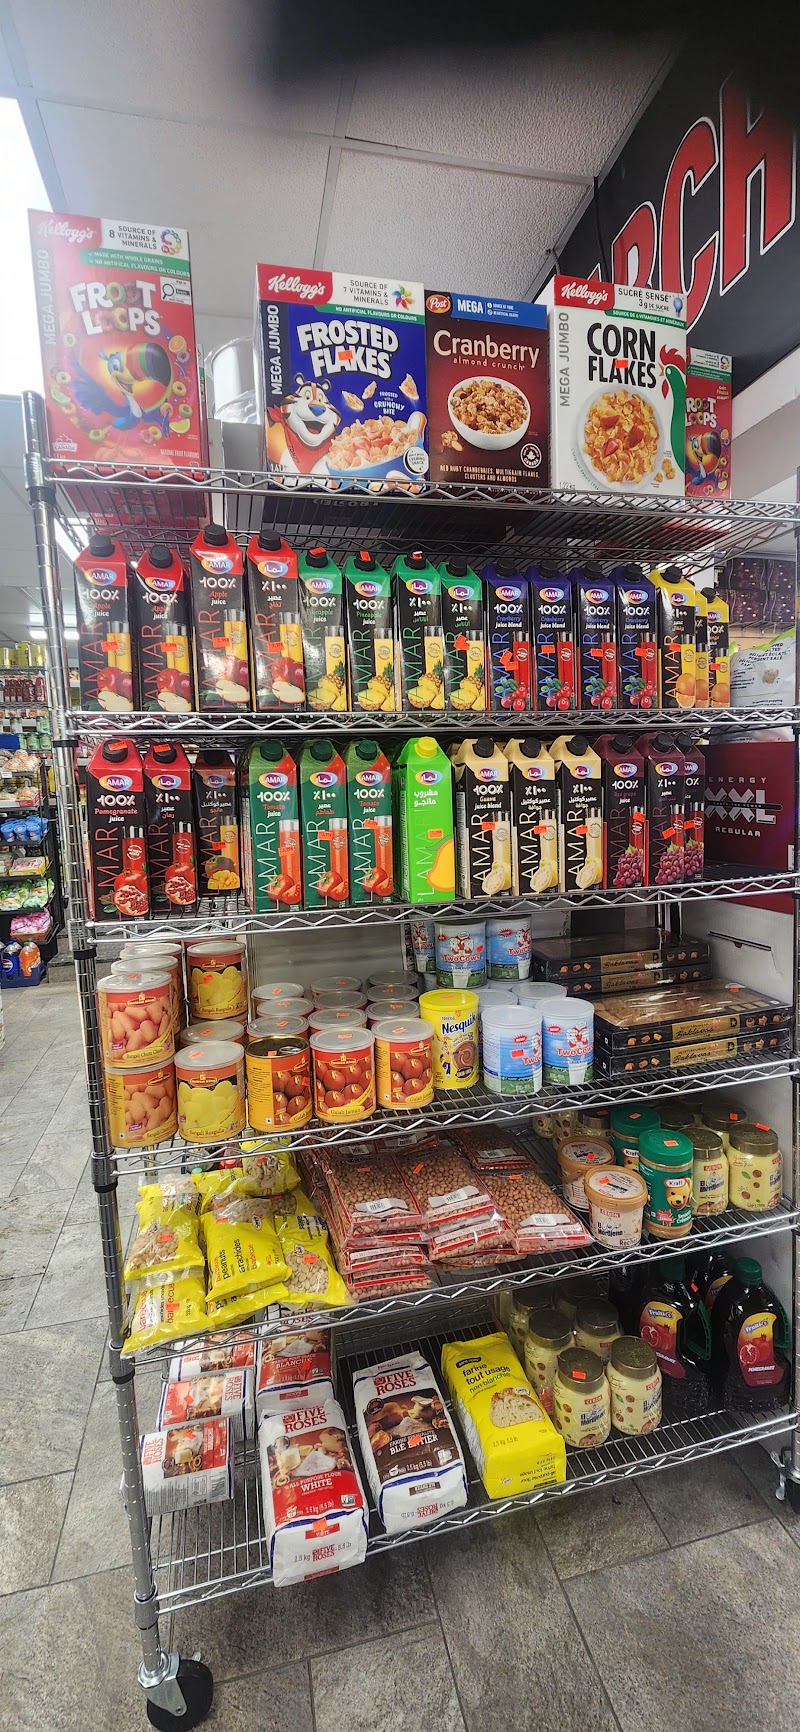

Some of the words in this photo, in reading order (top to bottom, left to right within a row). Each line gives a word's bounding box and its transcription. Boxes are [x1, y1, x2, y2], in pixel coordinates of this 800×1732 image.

[587, 68, 797, 336] RCH
[37, 219, 94, 244] Kellogg's
[109, 230, 115, 239] 8
[118, 226, 145, 234] SOURCE
[118, 232, 150, 242] VITAMINS
[122, 240, 157, 250] MINERALS
[36, 248, 53, 301] JUMBO
[268, 274, 326, 299] Kellogg's
[350, 280, 377, 290] SOURCE
[350, 287, 382, 298] VITAMINS
[561, 282, 609, 306] Kellogg's
[618, 288, 643, 298] SUCRÉ
[354, 297, 389, 306] MINERALS
[430, 297, 448, 310] Post
[458, 298, 484, 314] MEGA
[638, 298, 644, 306] 3
[644, 302, 648, 310] g
[656, 304, 670, 312] SUCRE
[343, 307, 368, 316] ARTIFICIAL
[368, 310, 390, 318] FLAVOURS
[397, 312, 418, 322] COLOURS
[42, 303, 57, 347] MEGA
[266, 304, 280, 354] JUMBO
[296, 320, 398, 353] FROSTED
[559, 312, 570, 362] JUMBO
[587, 322, 656, 362] CORN
[433, 330, 540, 368] Cranberry
[454, 356, 488, 367] almond
[492, 362, 524, 371] crunch
[270, 356, 283, 395] MEGA
[588, 356, 657, 389] FLAKES
[560, 368, 570, 406] MEGA
[374, 401, 405, 412] CRUNCHY
[487, 474, 496, 482] AND
[200, 577, 237, 590] 100%
[84, 588, 120, 600] 100%
[142, 592, 178, 604] 100%
[208, 590, 228, 598] Apple
[210, 598, 226, 606] juice
[304, 596, 336, 608] 100%
[353, 598, 385, 610] 100%
[94, 610, 110, 618] juice
[494, 604, 524, 614] 100%
[538, 604, 566, 615] 100%
[584, 606, 610, 616] 100%
[623, 606, 650, 616] 100%
[153, 612, 168, 620] juice
[540, 622, 552, 630] juice
[102, 778, 130, 786] LAMAR
[158, 776, 176, 786] لمار
[262, 776, 286, 784] LAMAR
[316, 775, 333, 784] لمار
[358, 774, 380, 782] LAMAR
[421, 773, 438, 781] لمار
[708, 776, 766, 784] ENERGY
[473, 784, 504, 796] 100%
[612, 780, 639, 790] 100%
[257, 791, 290, 803] 100%
[354, 788, 385, 799] 100%
[414, 790, 438, 798] مشروب
[97, 794, 136, 807] 100%
[414, 799, 436, 808] مانجو
[704, 788, 776, 824] XXL
[94, 808, 138, 816] Pomegranate
[267, 810, 281, 818] juice
[108, 815, 124, 823] juice
[716, 826, 761, 837] REGULAR
[352, 818, 373, 904] LAMAR
[471, 813, 492, 898] LAMAR
[148, 823, 172, 912] LAMAR
[256, 822, 280, 912] LAMAR
[306, 820, 328, 908] LAMAR
[442, 1013, 476, 1035] Nesquik
[234, 1239, 246, 1274] arachides
[218, 1250, 231, 1280] peanuts
[386, 1369, 414, 1383] FIVE
[462, 1363, 487, 1377] farine
[466, 1372, 484, 1385] tout
[485, 1366, 510, 1376] usage
[376, 1378, 416, 1396] ROSES
[470, 1384, 482, 1393] non
[483, 1372, 510, 1385] blanchie
[225, 1378, 234, 1400] ROSES
[297, 1407, 326, 1422] FIVE
[284, 1414, 327, 1434] ROSES
[145, 1440, 154, 1458] FIVE
[153, 1438, 163, 1463] ROSES
[300, 1475, 323, 1485] PURPOSE
[300, 1478, 332, 1492] WHITE
[313, 1506, 319, 1514] kg
[417, 1503, 438, 1512] ROSES
[312, 1552, 335, 1562] ROSES
